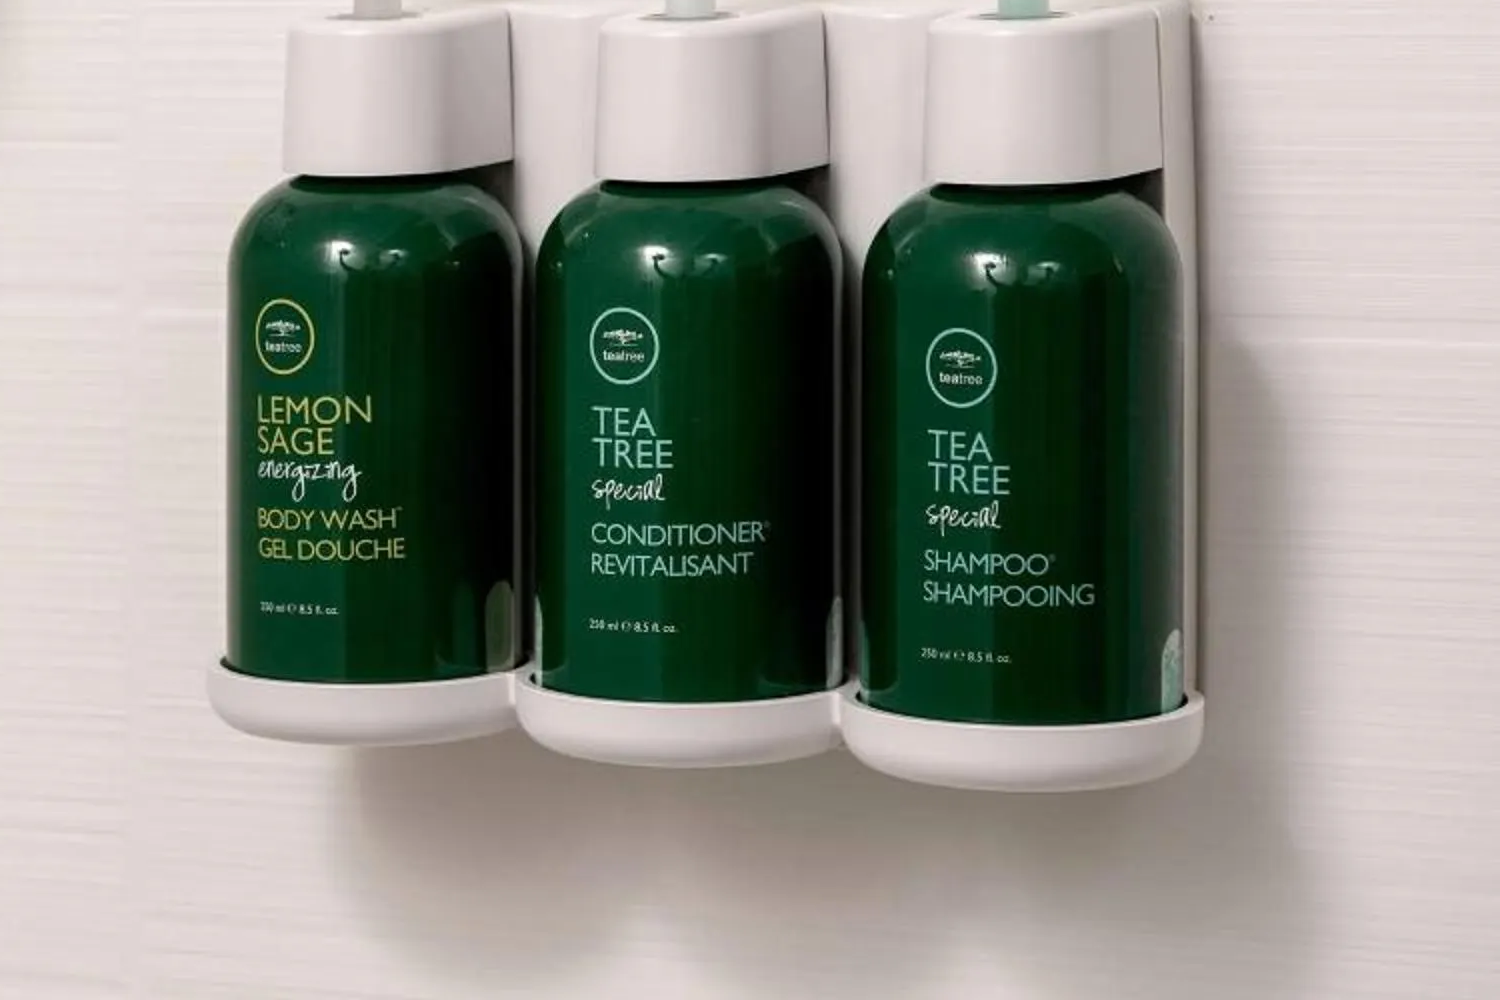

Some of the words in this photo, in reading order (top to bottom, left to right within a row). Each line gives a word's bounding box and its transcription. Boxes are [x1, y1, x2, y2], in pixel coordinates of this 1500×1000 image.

[603, 350, 645, 362] teatree
[939, 371, 983, 385] teatree
[257, 395, 372, 424] LEMON
[591, 405, 656, 437] TEA
[257, 426, 335, 455] SAGE
[591, 437, 674, 469] TREE
[927, 429, 993, 463] TEA
[257, 459, 362, 502] energizing
[591, 473, 666, 510] special
[927, 461, 1011, 495] TREE
[258, 507, 315, 530] BODY
[320, 508, 398, 530] WASH
[925, 500, 1001, 536] special
[259, 537, 292, 559] GEL
[298, 537, 405, 561] DOUCHE
[591, 552, 754, 577] REVITALISANT
[923, 581, 1095, 607] SHAMPOOING
